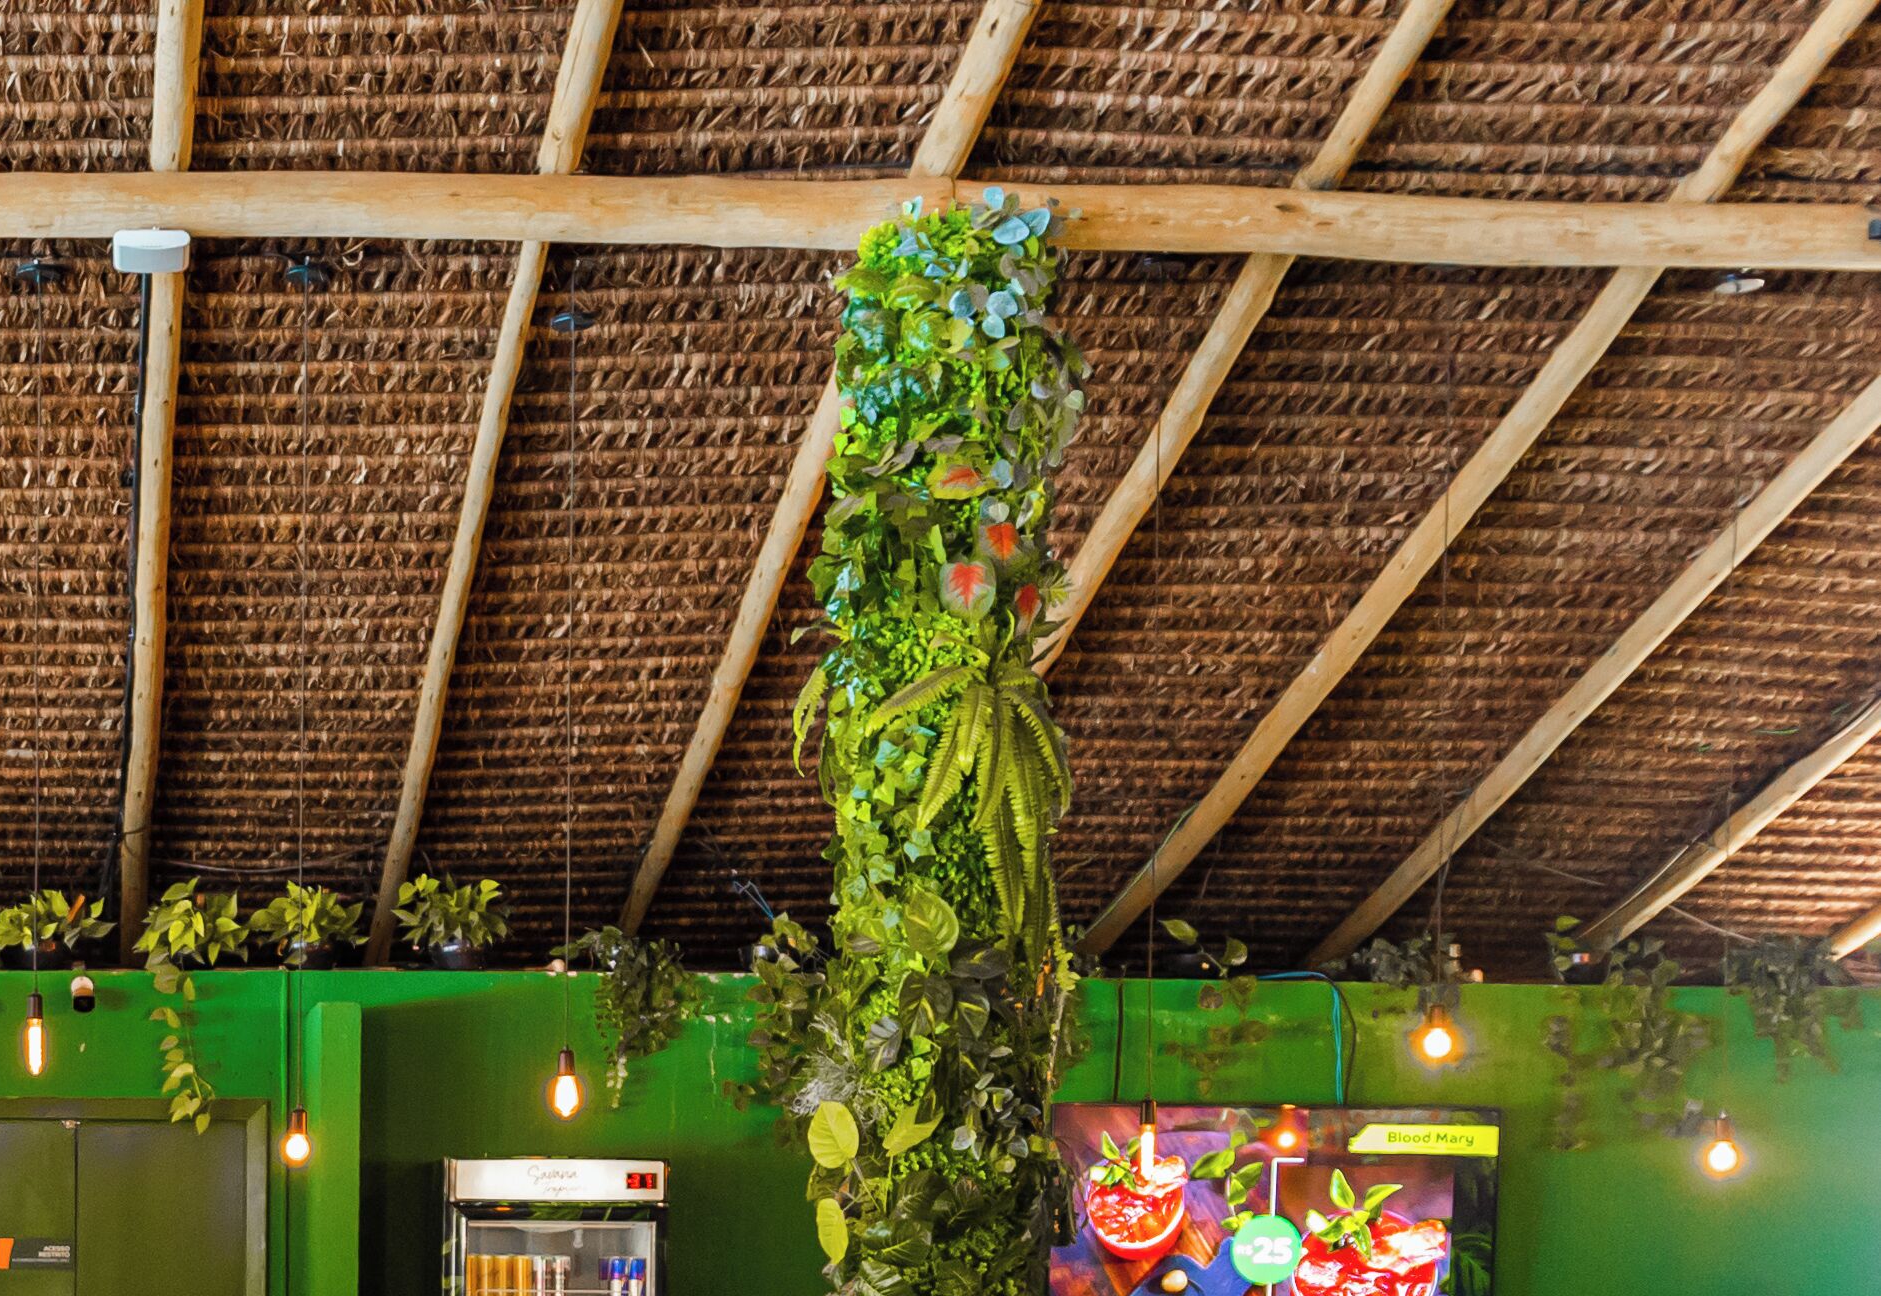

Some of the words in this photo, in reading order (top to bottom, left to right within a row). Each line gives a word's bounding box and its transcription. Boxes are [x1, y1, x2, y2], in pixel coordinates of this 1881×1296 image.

[1387, 1131, 1431, 1143] Blood
[1435, 1132, 1474, 1146] Mary
[1253, 1236, 1293, 1265] 25
